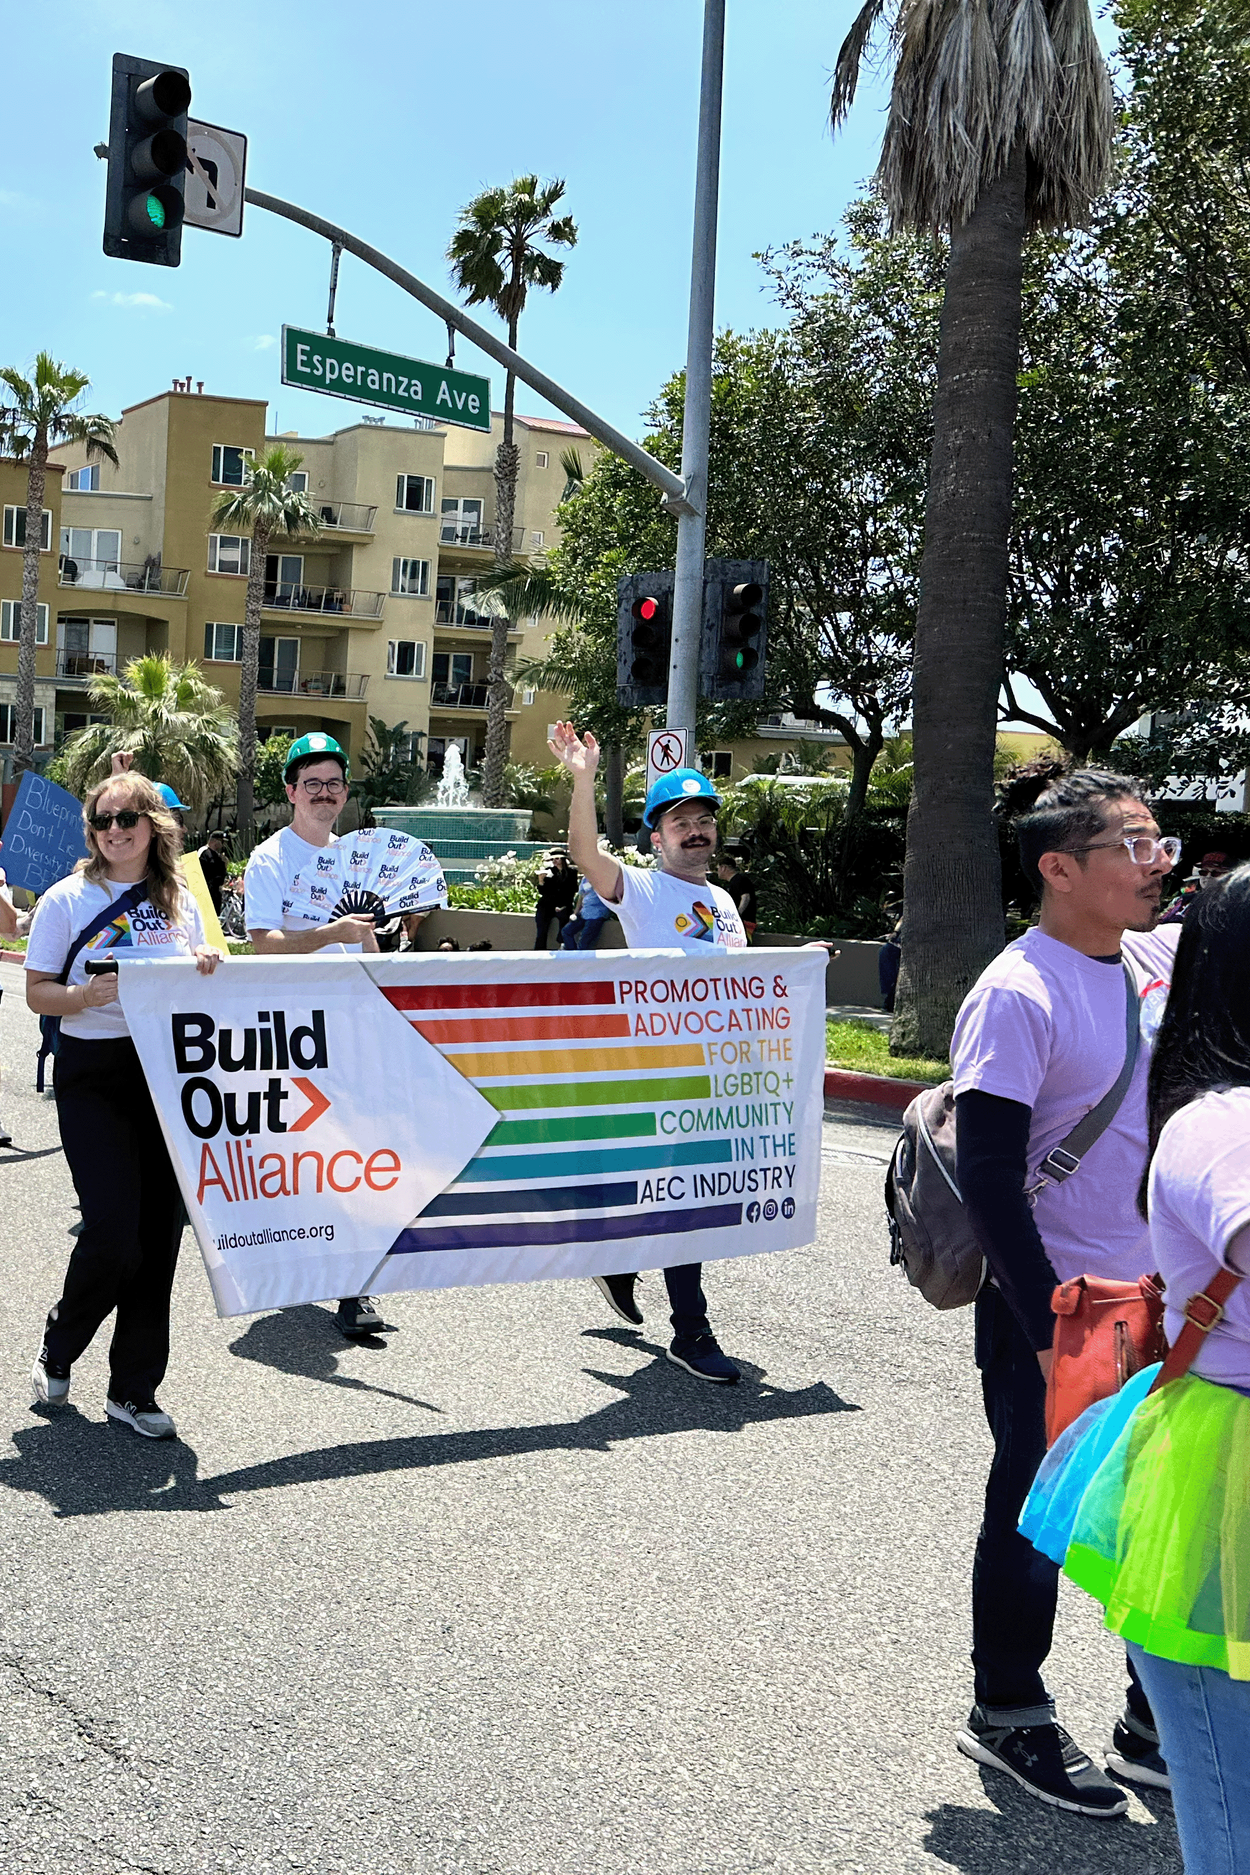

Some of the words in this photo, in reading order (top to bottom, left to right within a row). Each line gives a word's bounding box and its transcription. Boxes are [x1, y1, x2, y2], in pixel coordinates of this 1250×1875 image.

[296, 343, 424, 401] Esperanza
[436, 380, 481, 415] Ave
[25, 777, 83, 829] Blueprin
[387, 841, 402, 850] Out
[390, 835, 410, 843] Build
[317, 863, 330, 871] Out
[318, 856, 335, 866] Build
[350, 858, 363, 866] Out
[351, 851, 370, 859] Build
[380, 864, 399, 873] Build
[378, 871, 392, 879] Out
[311, 885, 327, 895] Build
[399, 900, 414, 908] Out
[132, 918, 165, 932] Out
[716, 919, 739, 934] Out
[619, 976, 765, 1004] PROMOTING
[773, 974, 789, 998] &
[634, 1006, 791, 1037] ADVOCATING
[171, 1009, 329, 1074] Build
[707, 1040, 751, 1066] FOR
[757, 1038, 792, 1062] THE
[713, 1070, 794, 1098] LGBTQ+
[180, 1076, 289, 1139] Out
[660, 1101, 794, 1135] COMMUNITY
[734, 1136, 755, 1162] IN
[759, 1132, 796, 1158] THE
[197, 1139, 402, 1206] Alliance
[640, 1176, 686, 1204] AEC
[693, 1164, 796, 1199] INDUSTRY
[213, 1224, 335, 1251] uildoutalliance.org
